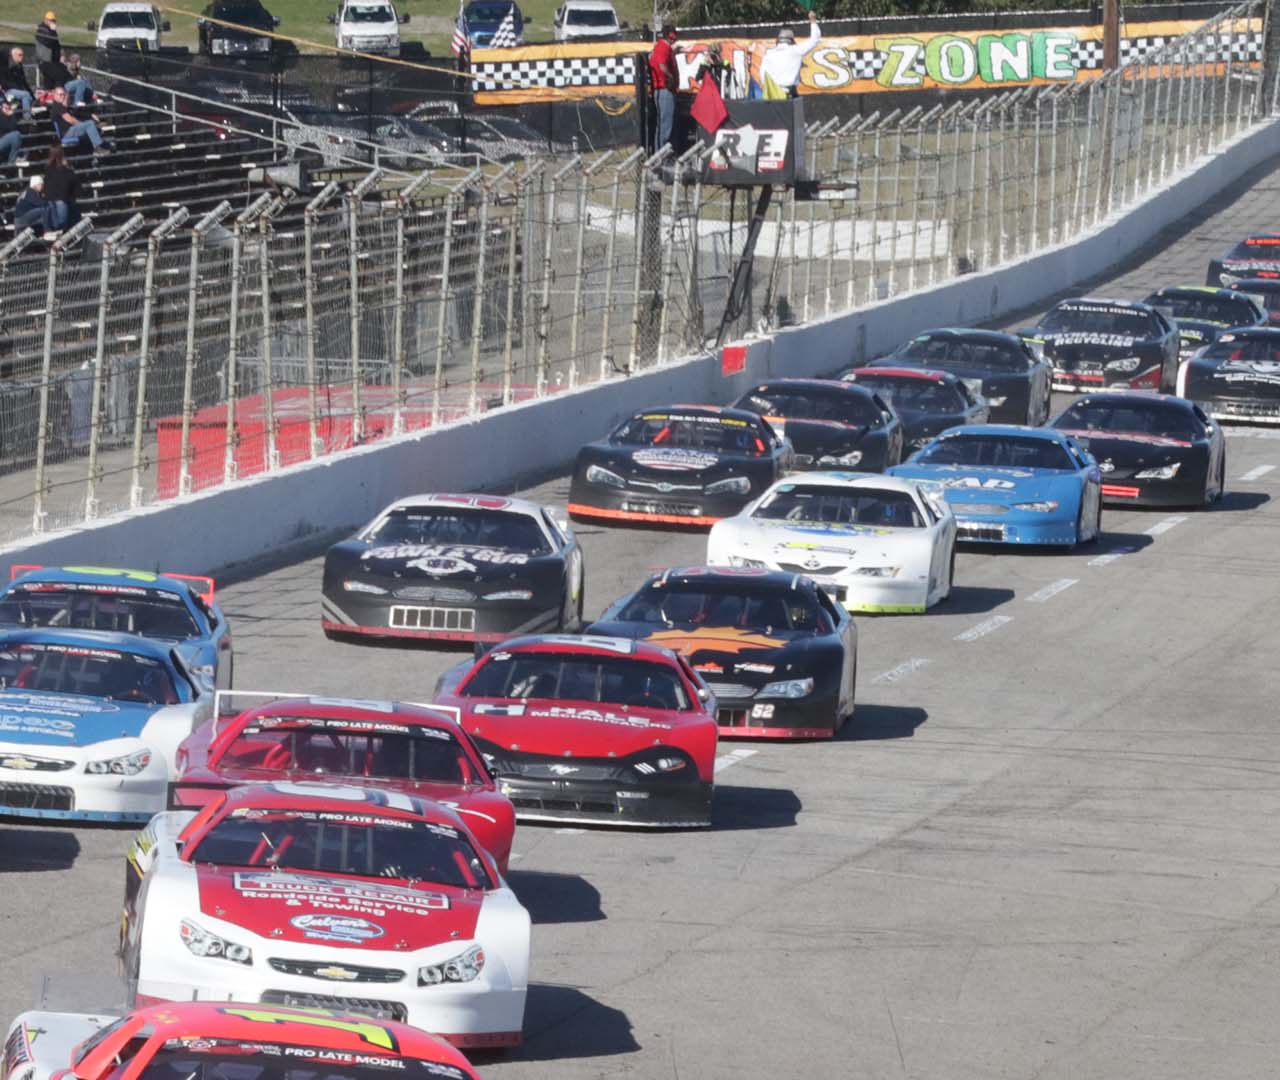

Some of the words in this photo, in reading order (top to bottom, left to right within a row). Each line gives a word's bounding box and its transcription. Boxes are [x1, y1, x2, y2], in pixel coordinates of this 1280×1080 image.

[886, 34, 1077, 86] ZONE
[551, 707, 651, 724] HALE
[751, 703, 776, 719] 52
[327, 720, 349, 728] PRO
[350, 722, 373, 730] LATE
[375, 723, 410, 733] MODEL
[320, 813, 344, 821] PRO
[346, 815, 373, 824] LATE
[375, 818, 413, 829] MODEL
[258, 881, 333, 896] TRUCK
[345, 887, 429, 905] REPAIR
[242, 890, 341, 904] Roadside
[347, 897, 429, 916] Service
[310, 900, 385, 917] Towing
[285, 1048, 317, 1059] PRO
[319, 1050, 353, 1062] LATE
[355, 1054, 407, 1069] MODEL
